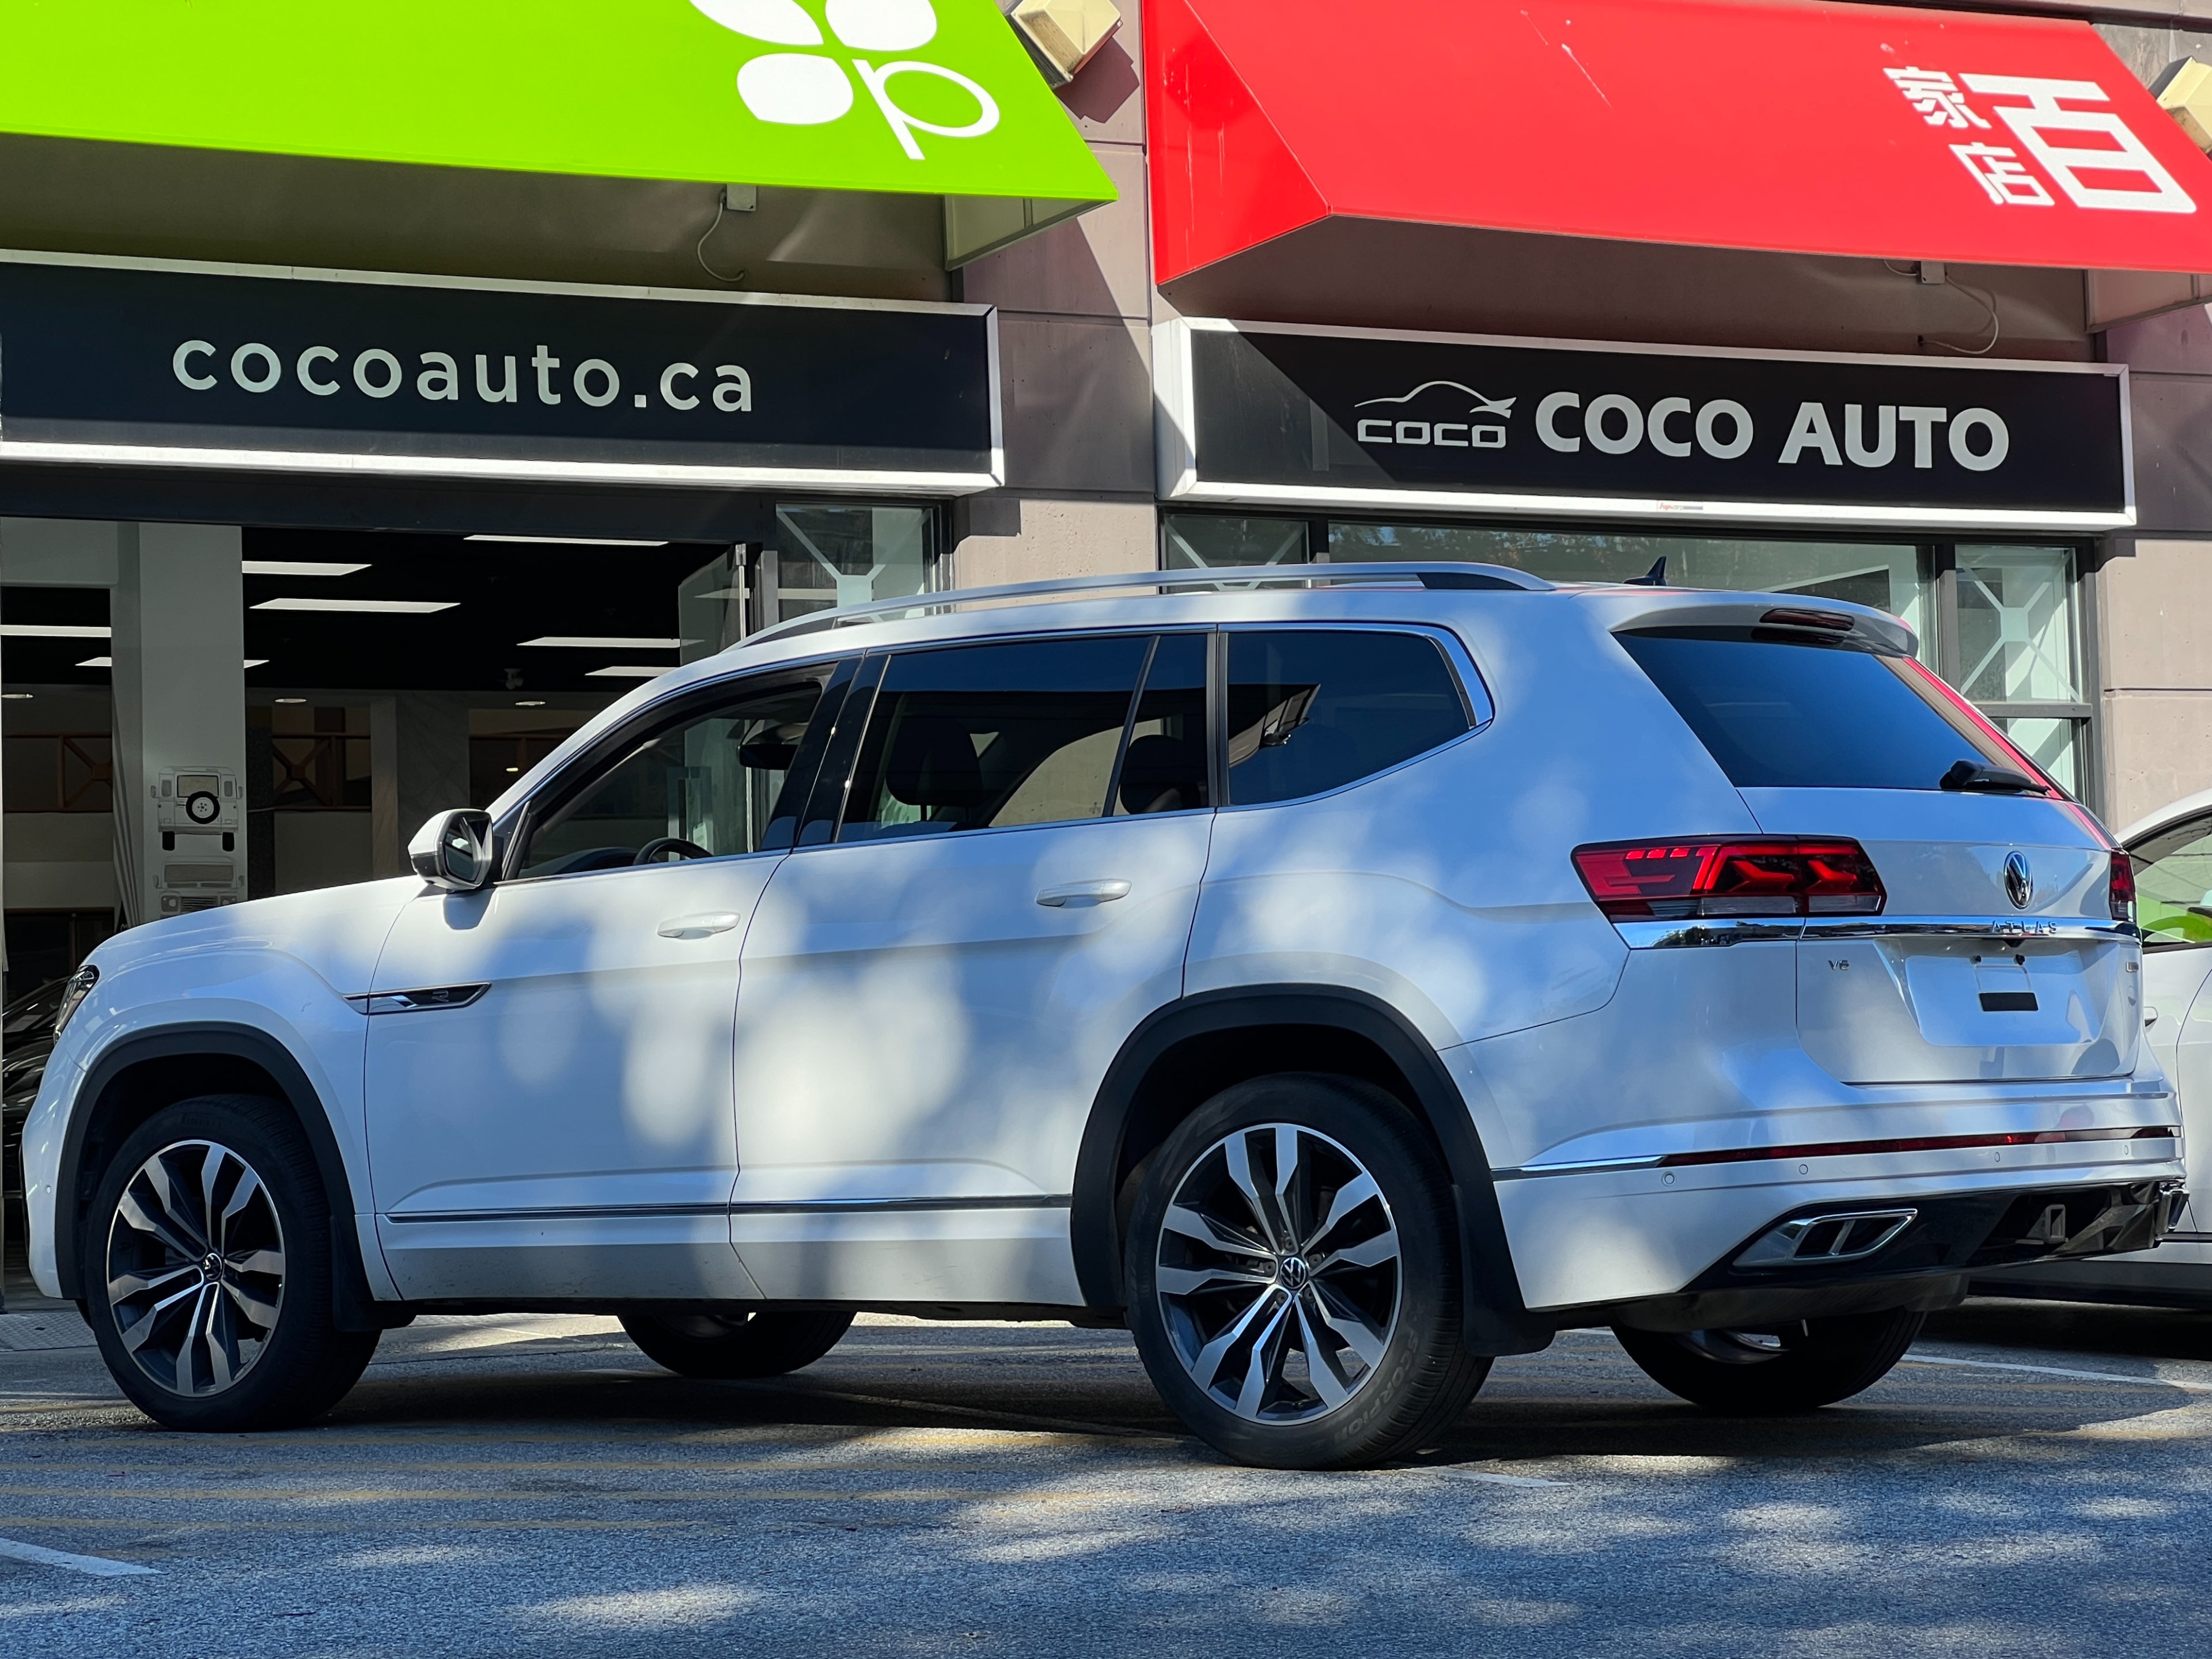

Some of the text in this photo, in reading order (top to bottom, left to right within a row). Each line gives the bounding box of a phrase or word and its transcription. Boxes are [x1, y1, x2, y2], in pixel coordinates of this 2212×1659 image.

[173, 340, 752, 412] cocoauto.ca
[1536, 392, 2009, 471] COCO AUTO
[1991, 920, 2058, 934] ATLAS
[1334, 1329, 1419, 1446] SCORPION
